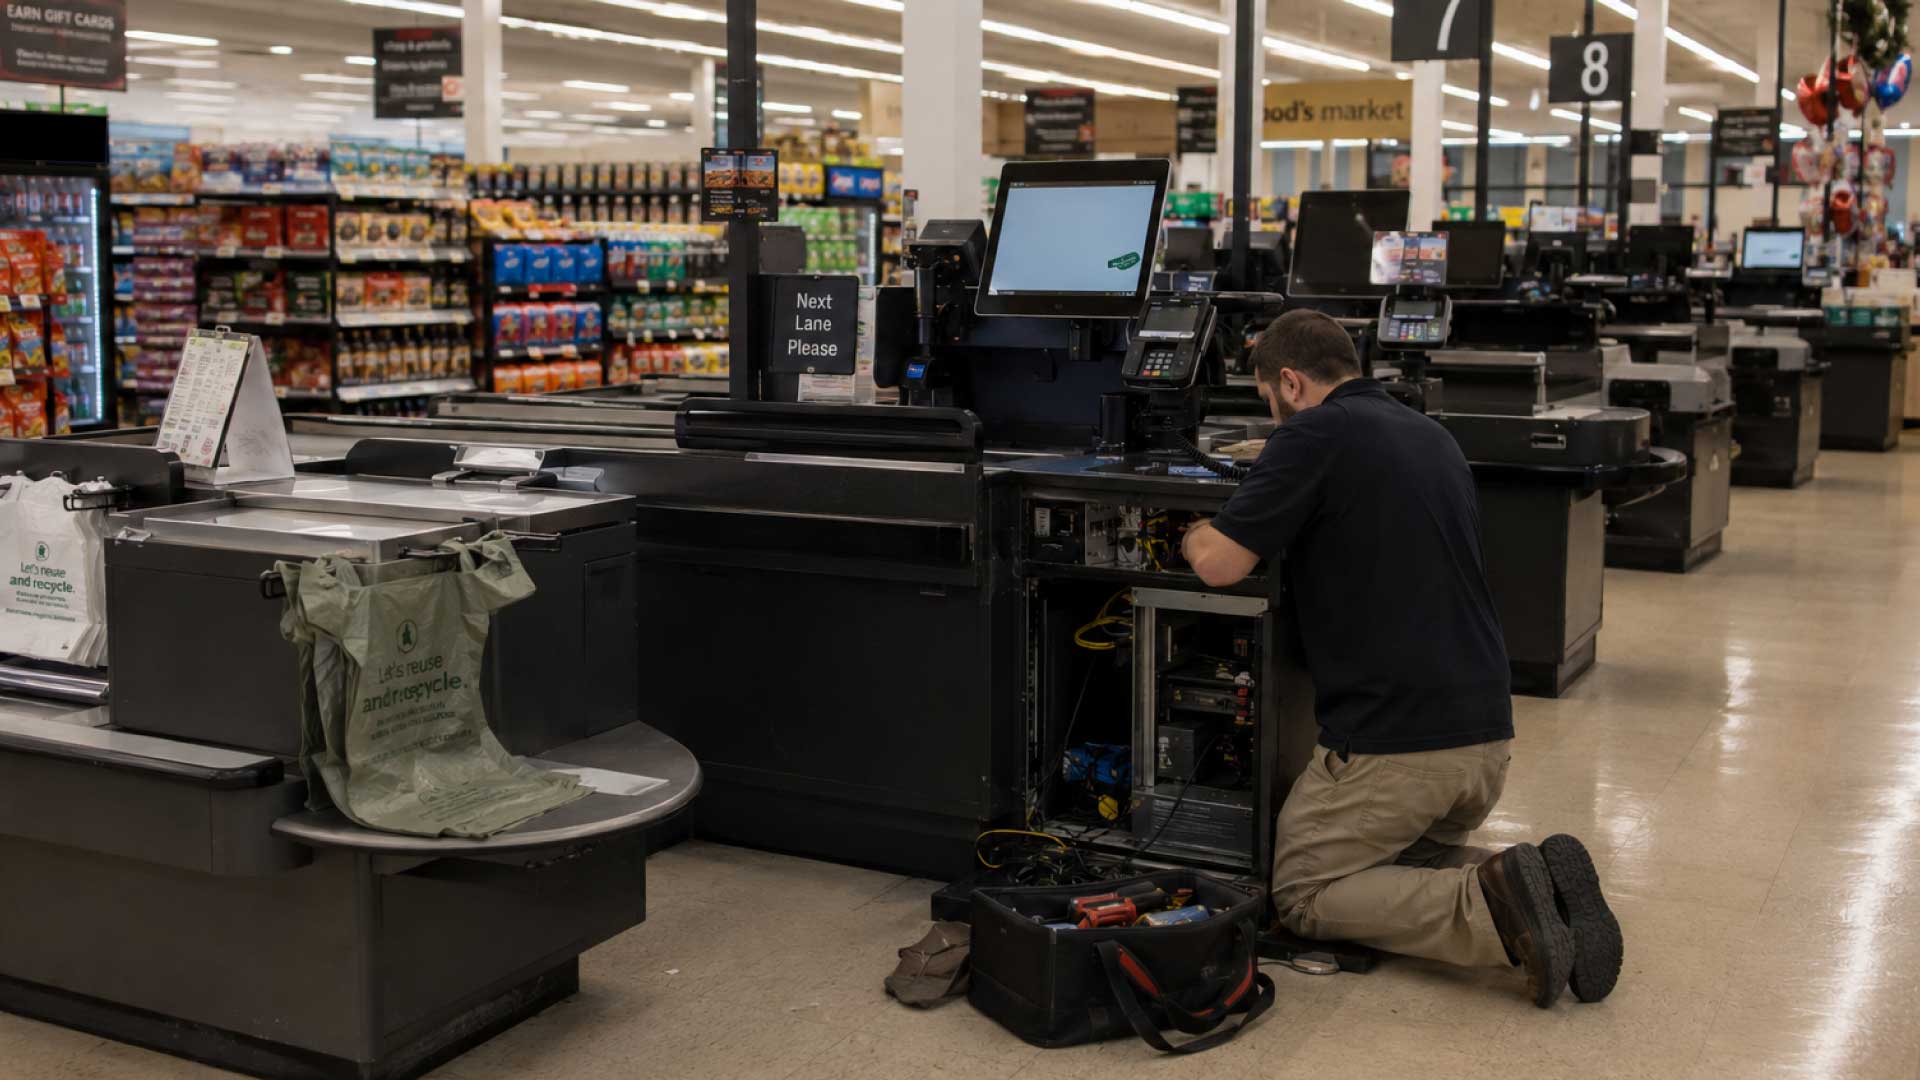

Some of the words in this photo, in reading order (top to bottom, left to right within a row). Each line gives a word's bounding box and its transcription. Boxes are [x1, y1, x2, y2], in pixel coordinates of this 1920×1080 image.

[7, 4, 41, 20] EARN
[45, 9, 72, 24] GIFT
[75, 13, 115, 30] CARDS
[1437, 0, 1458, 50] 7
[1581, 41, 1609, 96] 8
[1321, 98, 1405, 121] market
[797, 292, 832, 309] Next
[795, 314, 832, 332] Lane
[788, 339, 838, 356] Please
[9, 575, 31, 587] and
[33, 579, 76, 594] recycle.
[406, 655, 442, 675] reuse
[362, 687, 391, 713] and
